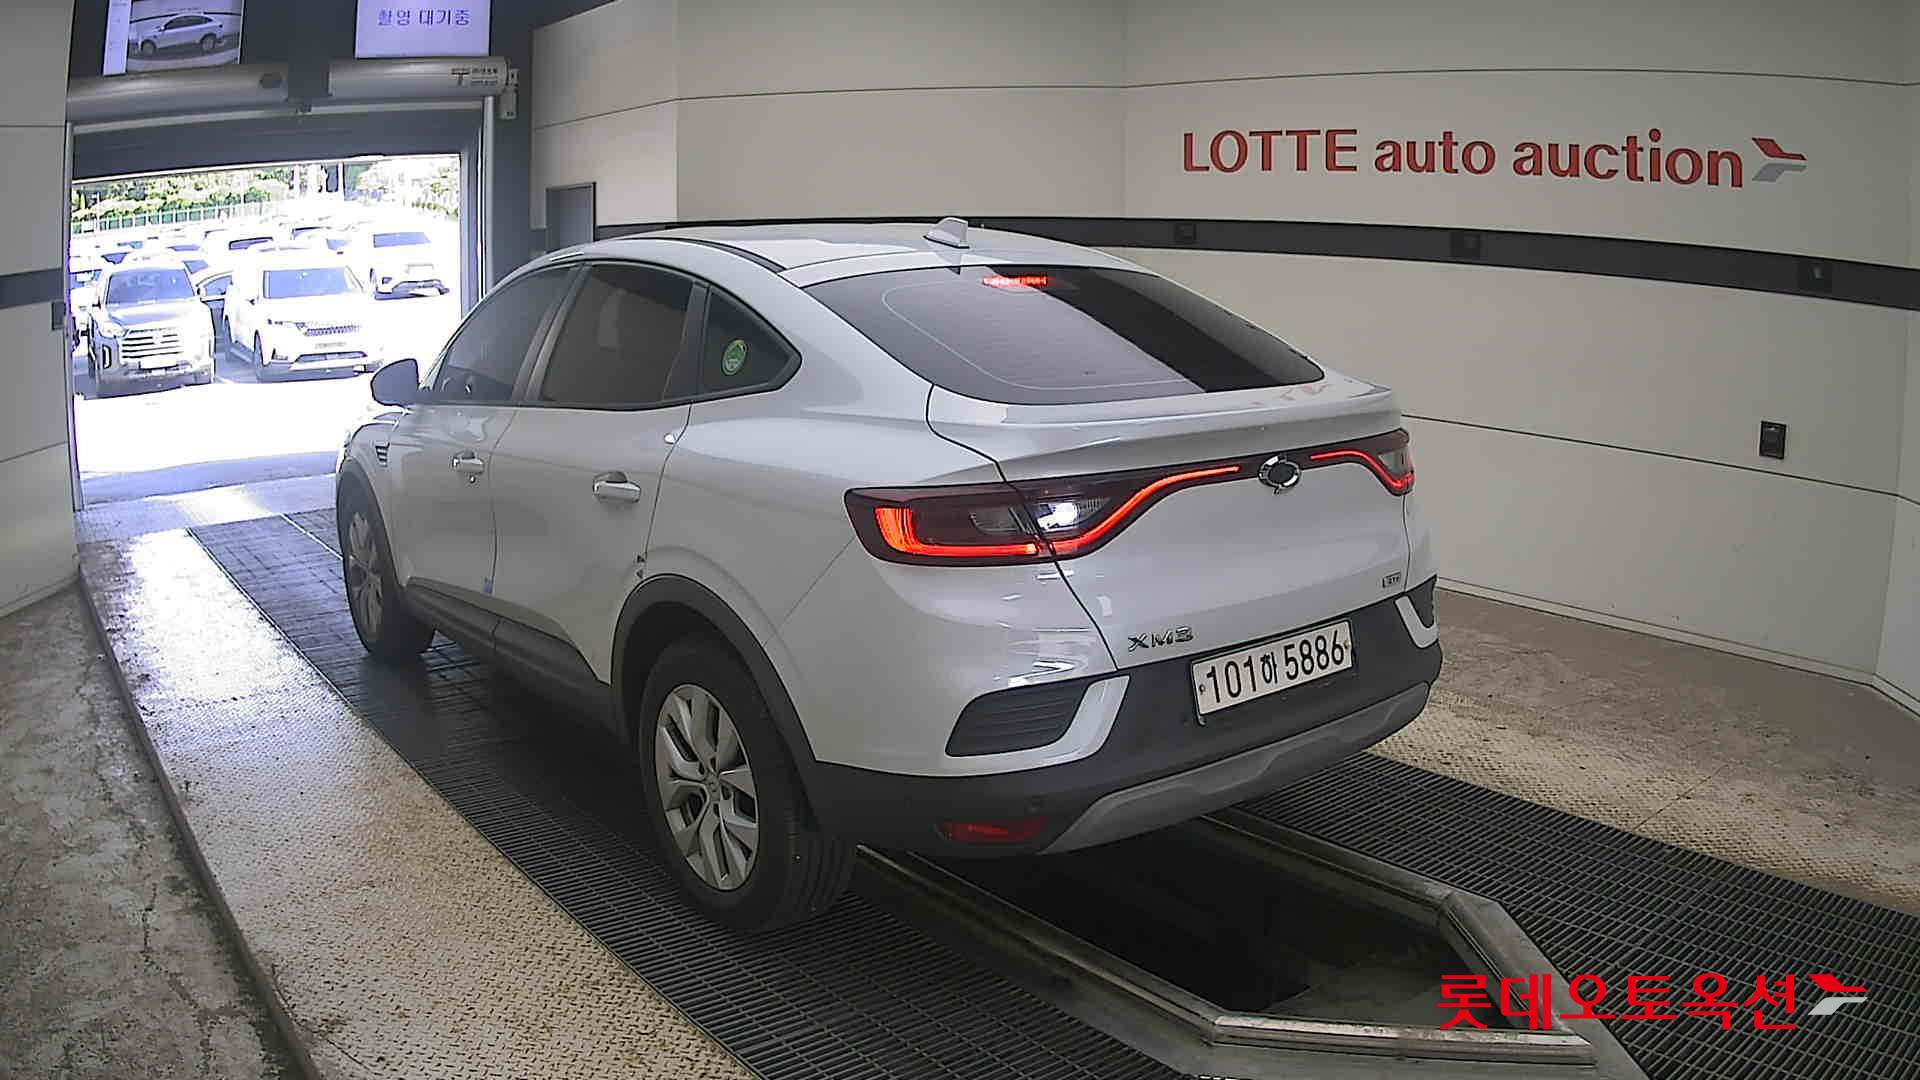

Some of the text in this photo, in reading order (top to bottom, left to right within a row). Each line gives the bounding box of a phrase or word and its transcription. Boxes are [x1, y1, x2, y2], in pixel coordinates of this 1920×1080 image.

[419, 8, 470, 26] 대기중
[1183, 128, 1743, 188] LOTTE auto auction
[1127, 625, 1194, 651] XM3
